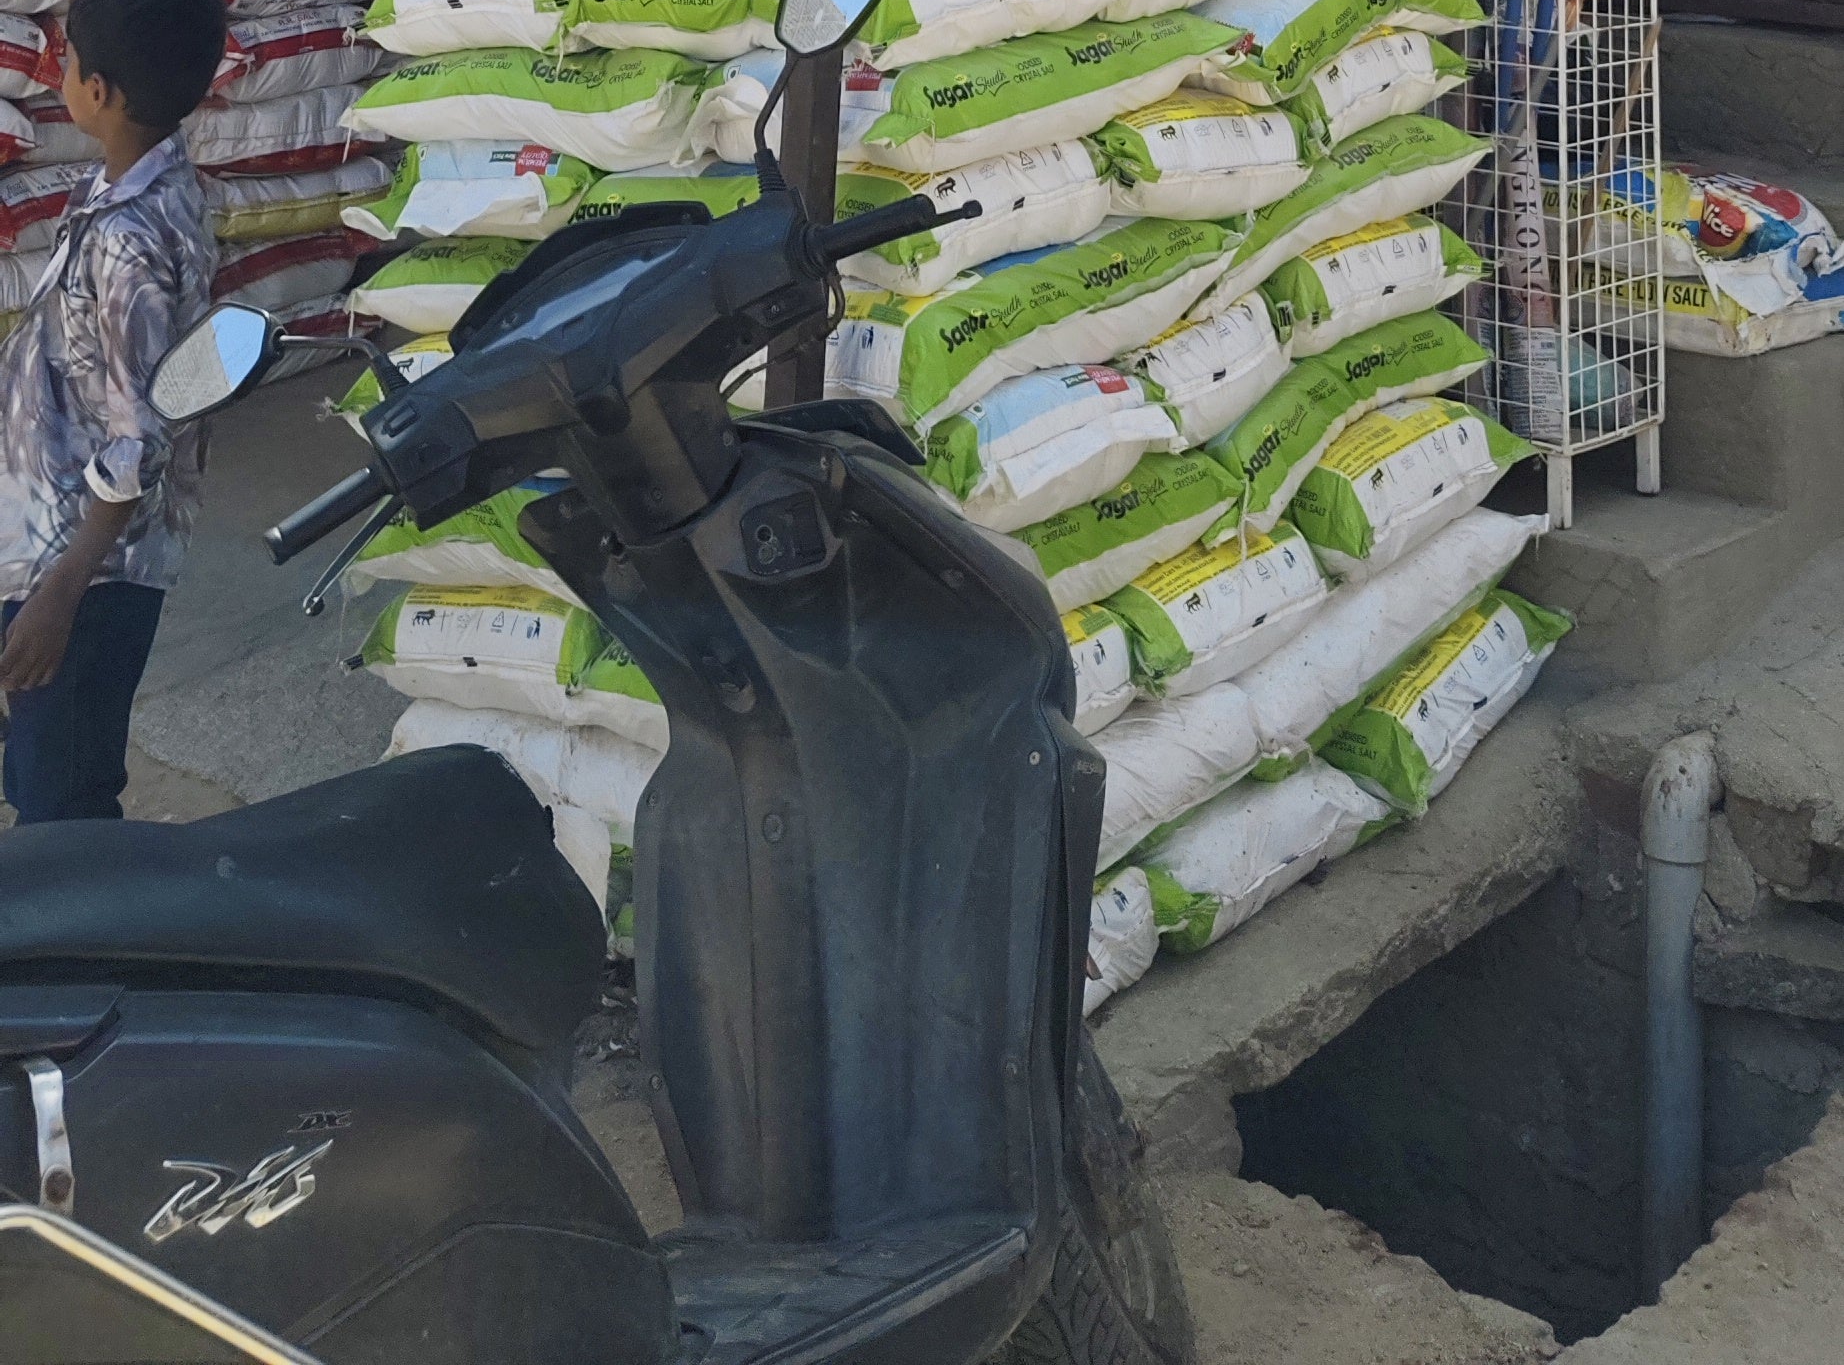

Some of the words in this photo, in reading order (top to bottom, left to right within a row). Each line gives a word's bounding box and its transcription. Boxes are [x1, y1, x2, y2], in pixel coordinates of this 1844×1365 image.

[1064, 39, 1115, 67] Sagar
[1113, 29, 1146, 54] Shudh
[923, 80, 974, 109] Sagar
[973, 70, 1010, 96] Shudh
[1329, 144, 1373, 170] Sagar
[1078, 258, 1129, 290] Sagar
[1673, 285, 1709, 309] SALT
[939, 311, 989, 353] Sagar
[988, 296, 1026, 329] Shudh
[1345, 350, 1387, 382] Sagar
[1091, 488, 1141, 521] Sagar
[1309, 504, 1328, 517] SALT
[1358, 746, 1378, 760] SALT
